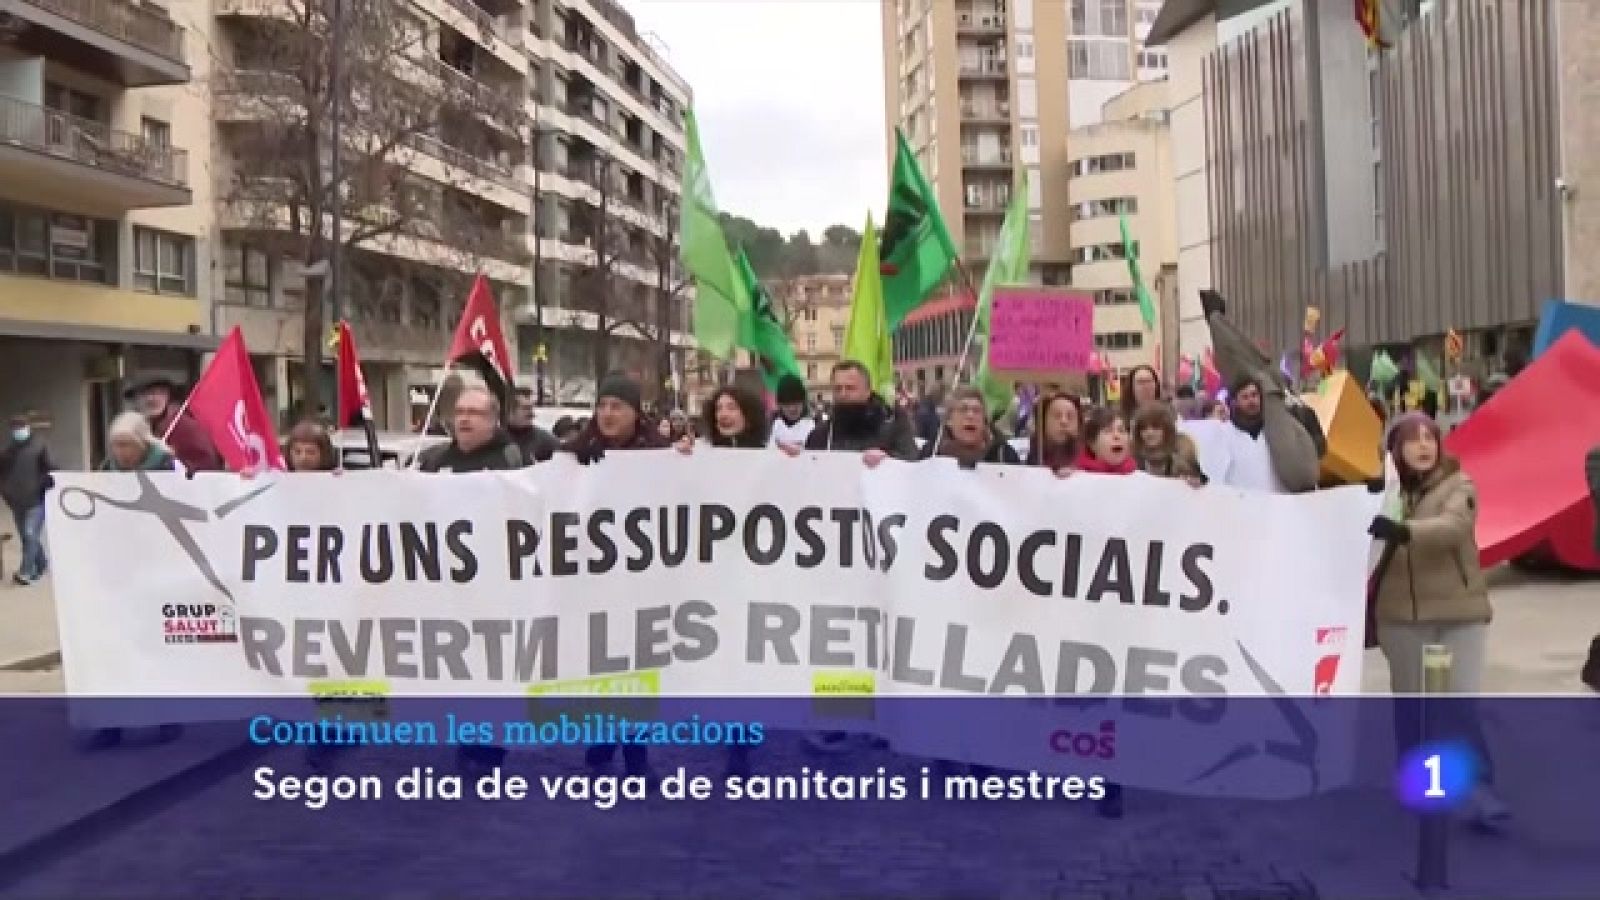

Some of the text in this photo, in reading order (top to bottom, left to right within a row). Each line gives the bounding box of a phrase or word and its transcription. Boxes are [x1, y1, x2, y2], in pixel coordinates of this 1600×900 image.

[241, 503, 1229, 615] PER UNS PESSUPOSTOS SOCIALS.
[162, 604, 216, 618] GRUP
[164, 619, 218, 633] SALUT
[588, 600, 719, 675] LES
[745, 601, 1230, 724] RETLLADES
